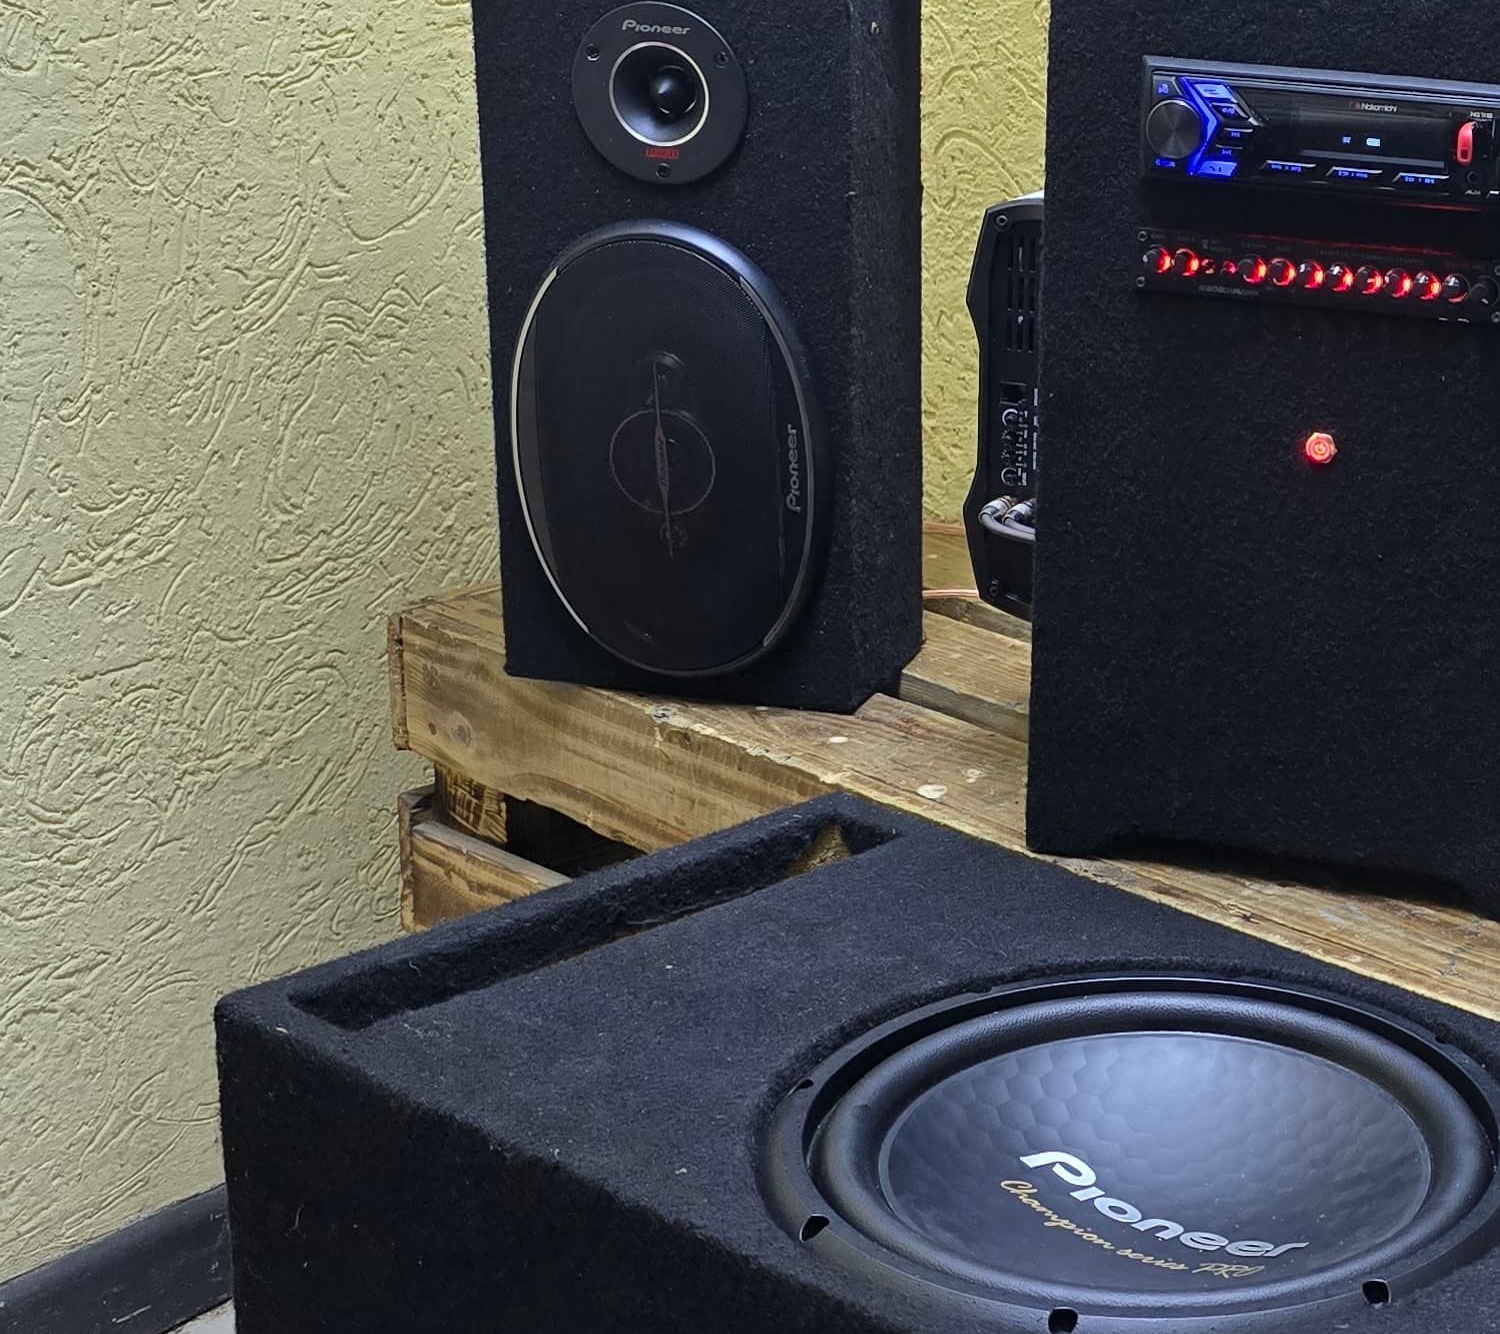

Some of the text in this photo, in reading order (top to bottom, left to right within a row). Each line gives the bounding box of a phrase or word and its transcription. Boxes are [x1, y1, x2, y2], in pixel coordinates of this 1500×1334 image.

[622, 19, 690, 34] Pioneer
[786, 423, 801, 513] Pioneer
[1000, 1180, 1265, 1279] Champion series PRO
[1019, 1151, 1309, 1257] Pioneer
